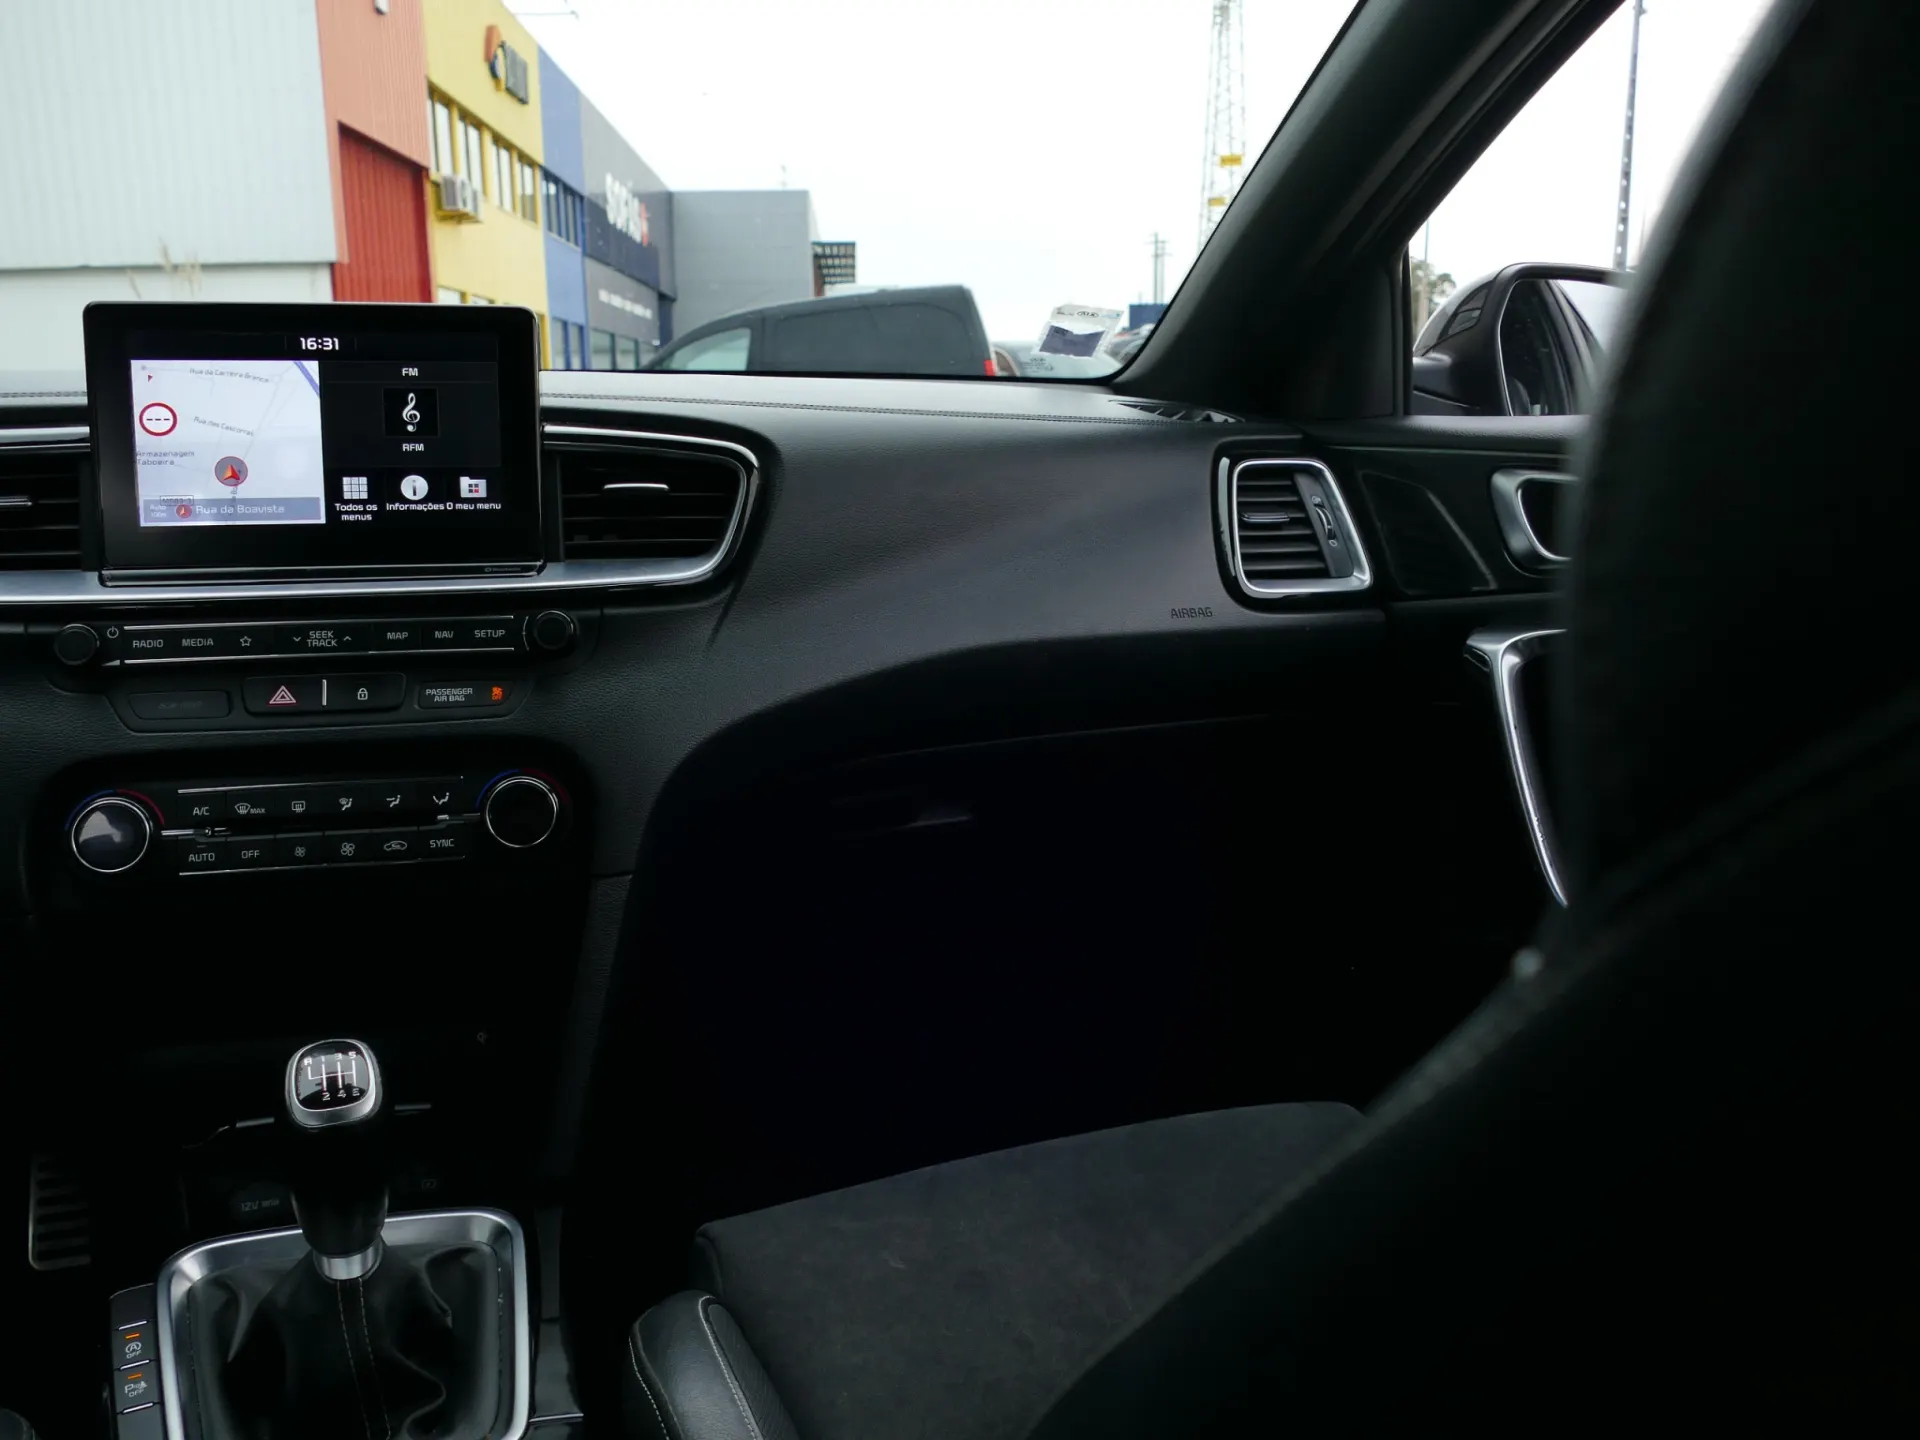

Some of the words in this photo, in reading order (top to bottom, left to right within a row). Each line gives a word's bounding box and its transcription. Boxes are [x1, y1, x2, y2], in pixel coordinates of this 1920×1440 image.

[300, 337, 339, 350] 16:31
[189, 367, 203, 375] Rua
[402, 367, 419, 376] FM
[193, 416, 206, 424] Rua
[402, 443, 424, 452] RFM
[196, 505, 217, 514] Rua
[220, 504, 234, 514] da
[237, 503, 285, 513] Boavista
[334, 503, 364, 511] Todos
[386, 502, 444, 512] Informações
[477, 502, 501, 510] menu
[341, 513, 372, 521] menus
[1170, 606, 1213, 619] AIRBAG
[309, 630, 335, 639] SEEK
[386, 631, 409, 640] MAP
[434, 630, 454, 639] NAV
[474, 629, 506, 638] SETUP
[132, 639, 164, 648] RADIO
[181, 638, 214, 647] MEDIA
[306, 638, 338, 647] TRACK
[425, 687, 473, 696] PASSENGER
[448, 694, 465, 702] BAG
[192, 806, 210, 816] A/C
[249, 807, 267, 815] MAX
[429, 838, 455, 848] SYNC
[188, 852, 216, 862] AUTO
[241, 850, 260, 859] OFF
[348, 1051, 357, 1059] 5
[322, 1092, 331, 1101] 2
[337, 1089, 347, 1098] 4
[126, 1350, 142, 1359] OFF
[128, 1388, 144, 1398] OFF
